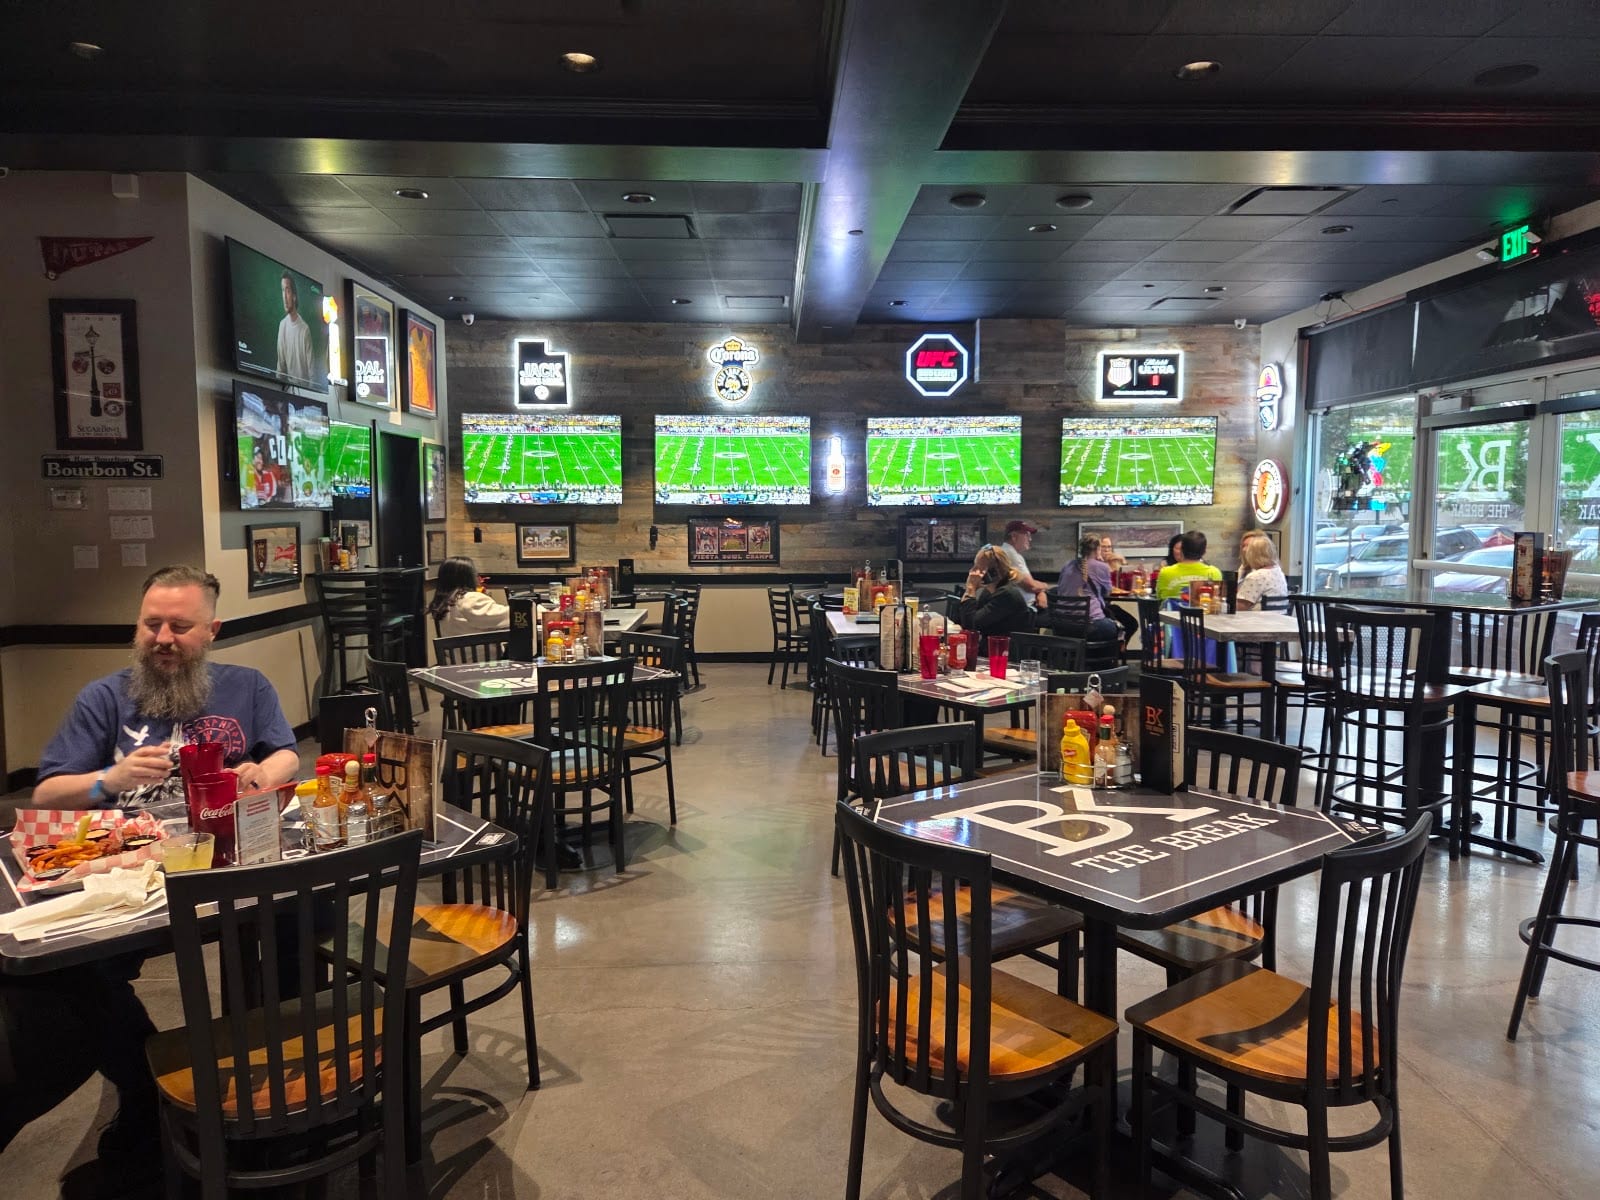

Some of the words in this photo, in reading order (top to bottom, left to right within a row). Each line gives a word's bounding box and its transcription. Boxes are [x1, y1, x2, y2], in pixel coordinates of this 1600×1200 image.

[1502, 225, 1529, 261] EXIT
[709, 347, 757, 364] Corona
[916, 350, 958, 368] UFC
[519, 362, 563, 378] JACK
[1138, 365, 1175, 374] ULTRA
[46, 462, 127, 477] Bourbon
[133, 462, 159, 477] St.
[1144, 705, 1164, 727] BK
[1070, 843, 1171, 875] THE
[1160, 812, 1281, 859] BREAK
